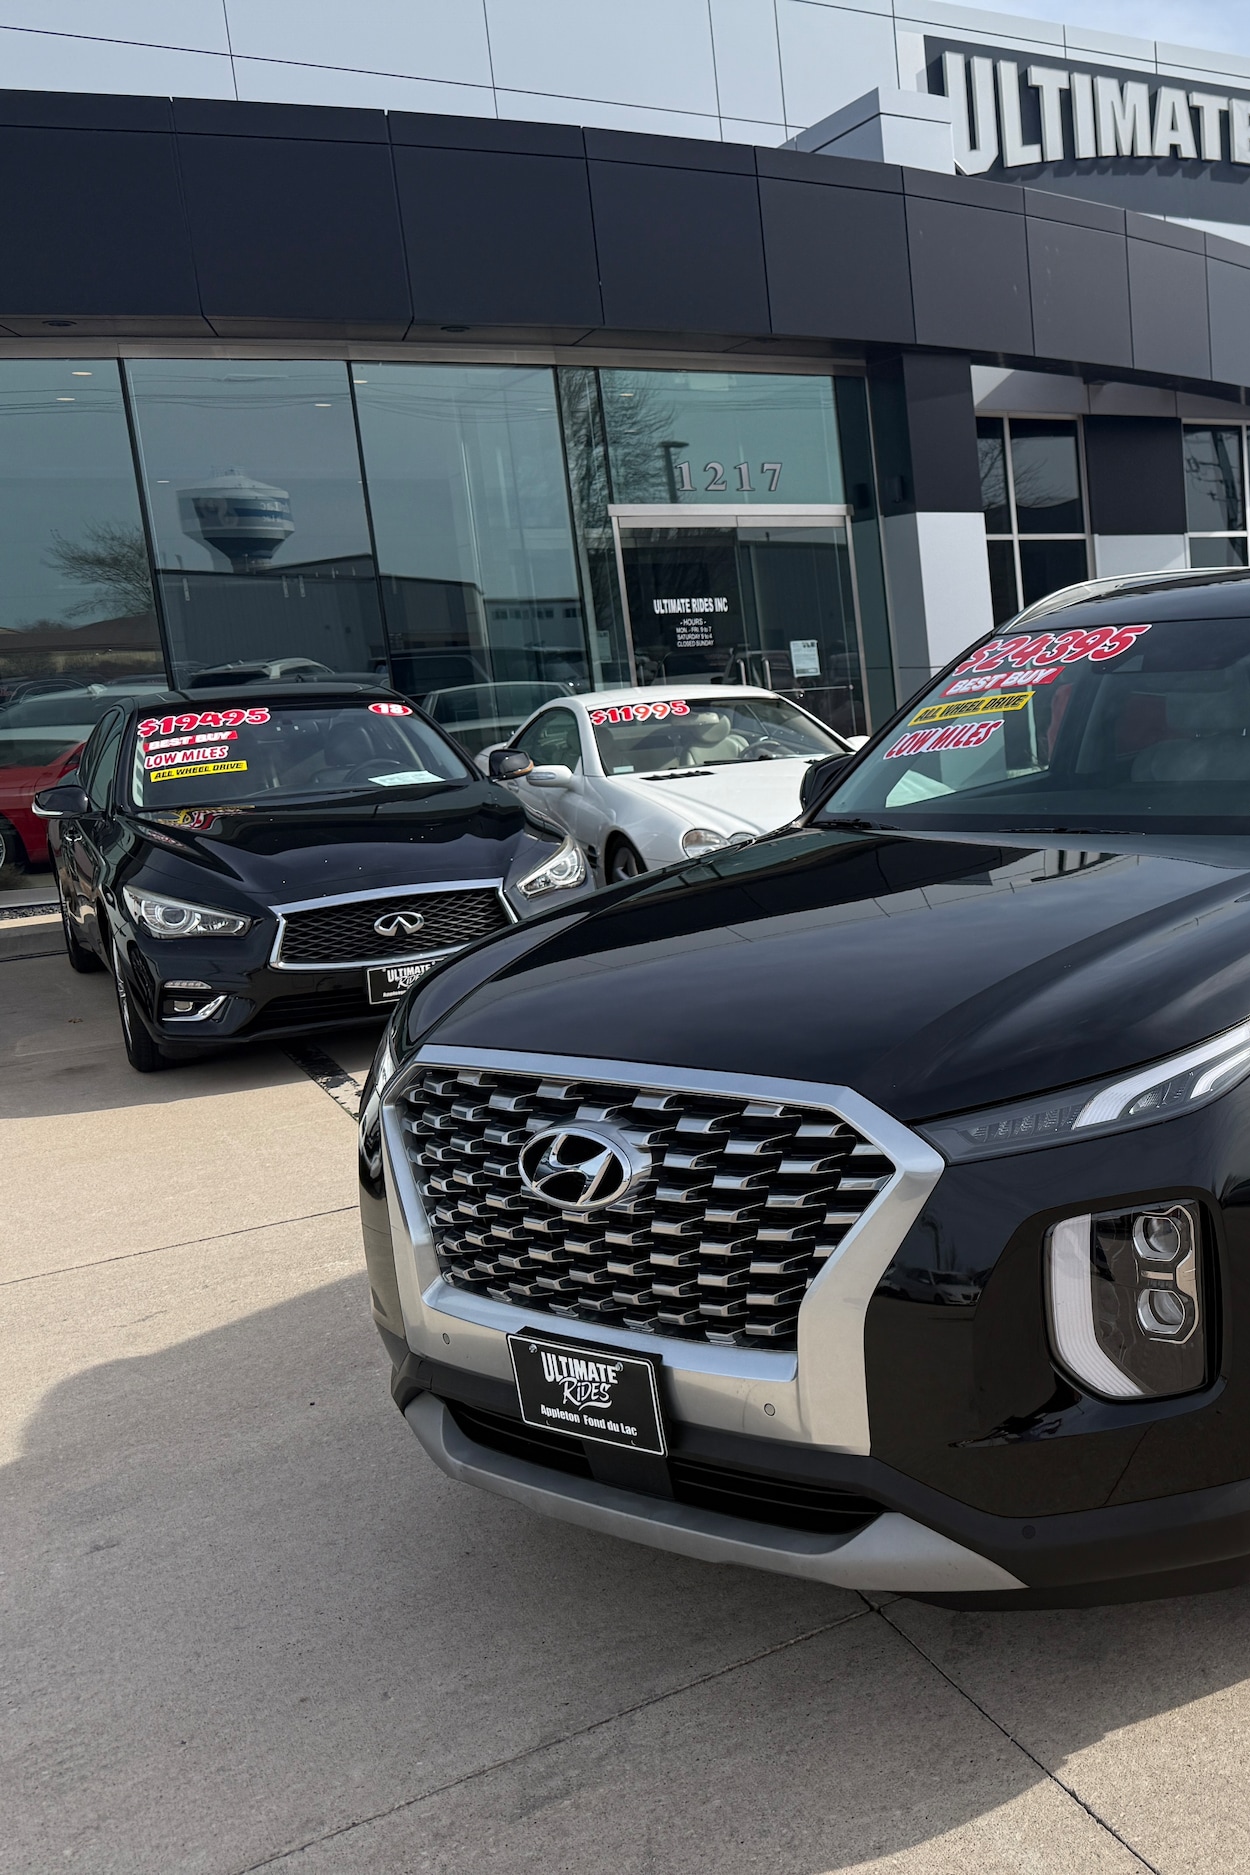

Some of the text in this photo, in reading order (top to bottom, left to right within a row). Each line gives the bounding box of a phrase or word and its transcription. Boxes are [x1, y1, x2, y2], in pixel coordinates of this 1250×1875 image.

[676, 461, 783, 491] 1217
[653, 597, 728, 614] ULTIMATE RIDES INC
[683, 618, 703, 626] HOURS
[951, 624, 1152, 677] $24395
[946, 667, 1058, 696] BEST BUY
[379, 703, 404, 714] 18
[590, 700, 690, 725] $11995
[914, 692, 1028, 722] ALL WHEEL DRIVE
[137, 707, 271, 738] $19495
[149, 731, 233, 751] BEST BUY
[883, 720, 1005, 760] LOW MILES
[145, 746, 229, 769] LOW MILES
[155, 762, 243, 780] ALL WHEEL DRIVE
[541, 1351, 618, 1384] ULTIMATE
[540, 1404, 638, 1436] Appleton Fond du Lac
